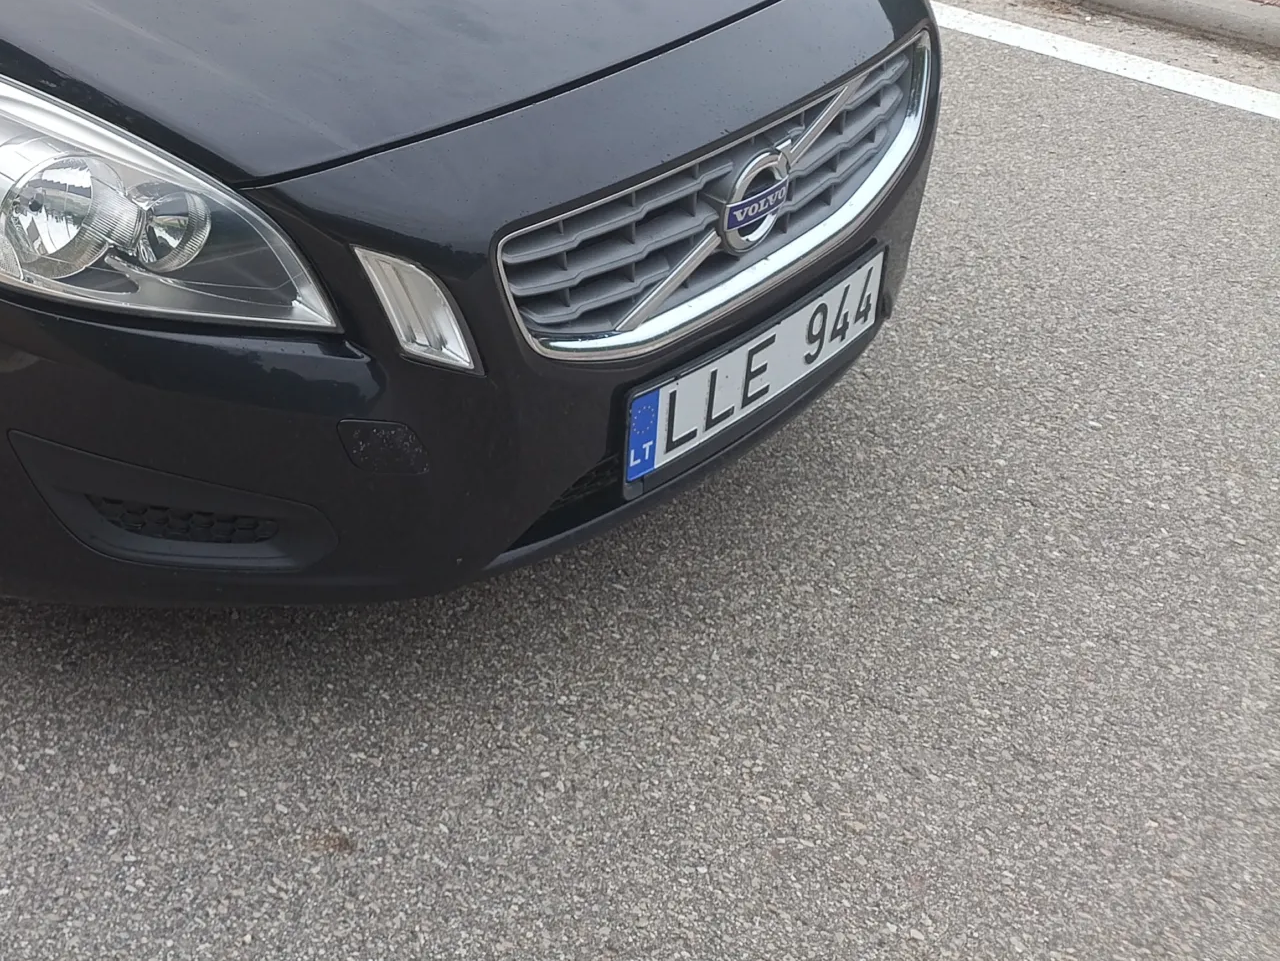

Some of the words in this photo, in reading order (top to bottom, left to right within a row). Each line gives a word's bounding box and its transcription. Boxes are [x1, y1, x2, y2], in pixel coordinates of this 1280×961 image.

[733, 186, 786, 221] VOLVO
[665, 334, 777, 453] LLE
[804, 267, 873, 365] 944
[630, 441, 653, 467] LT
